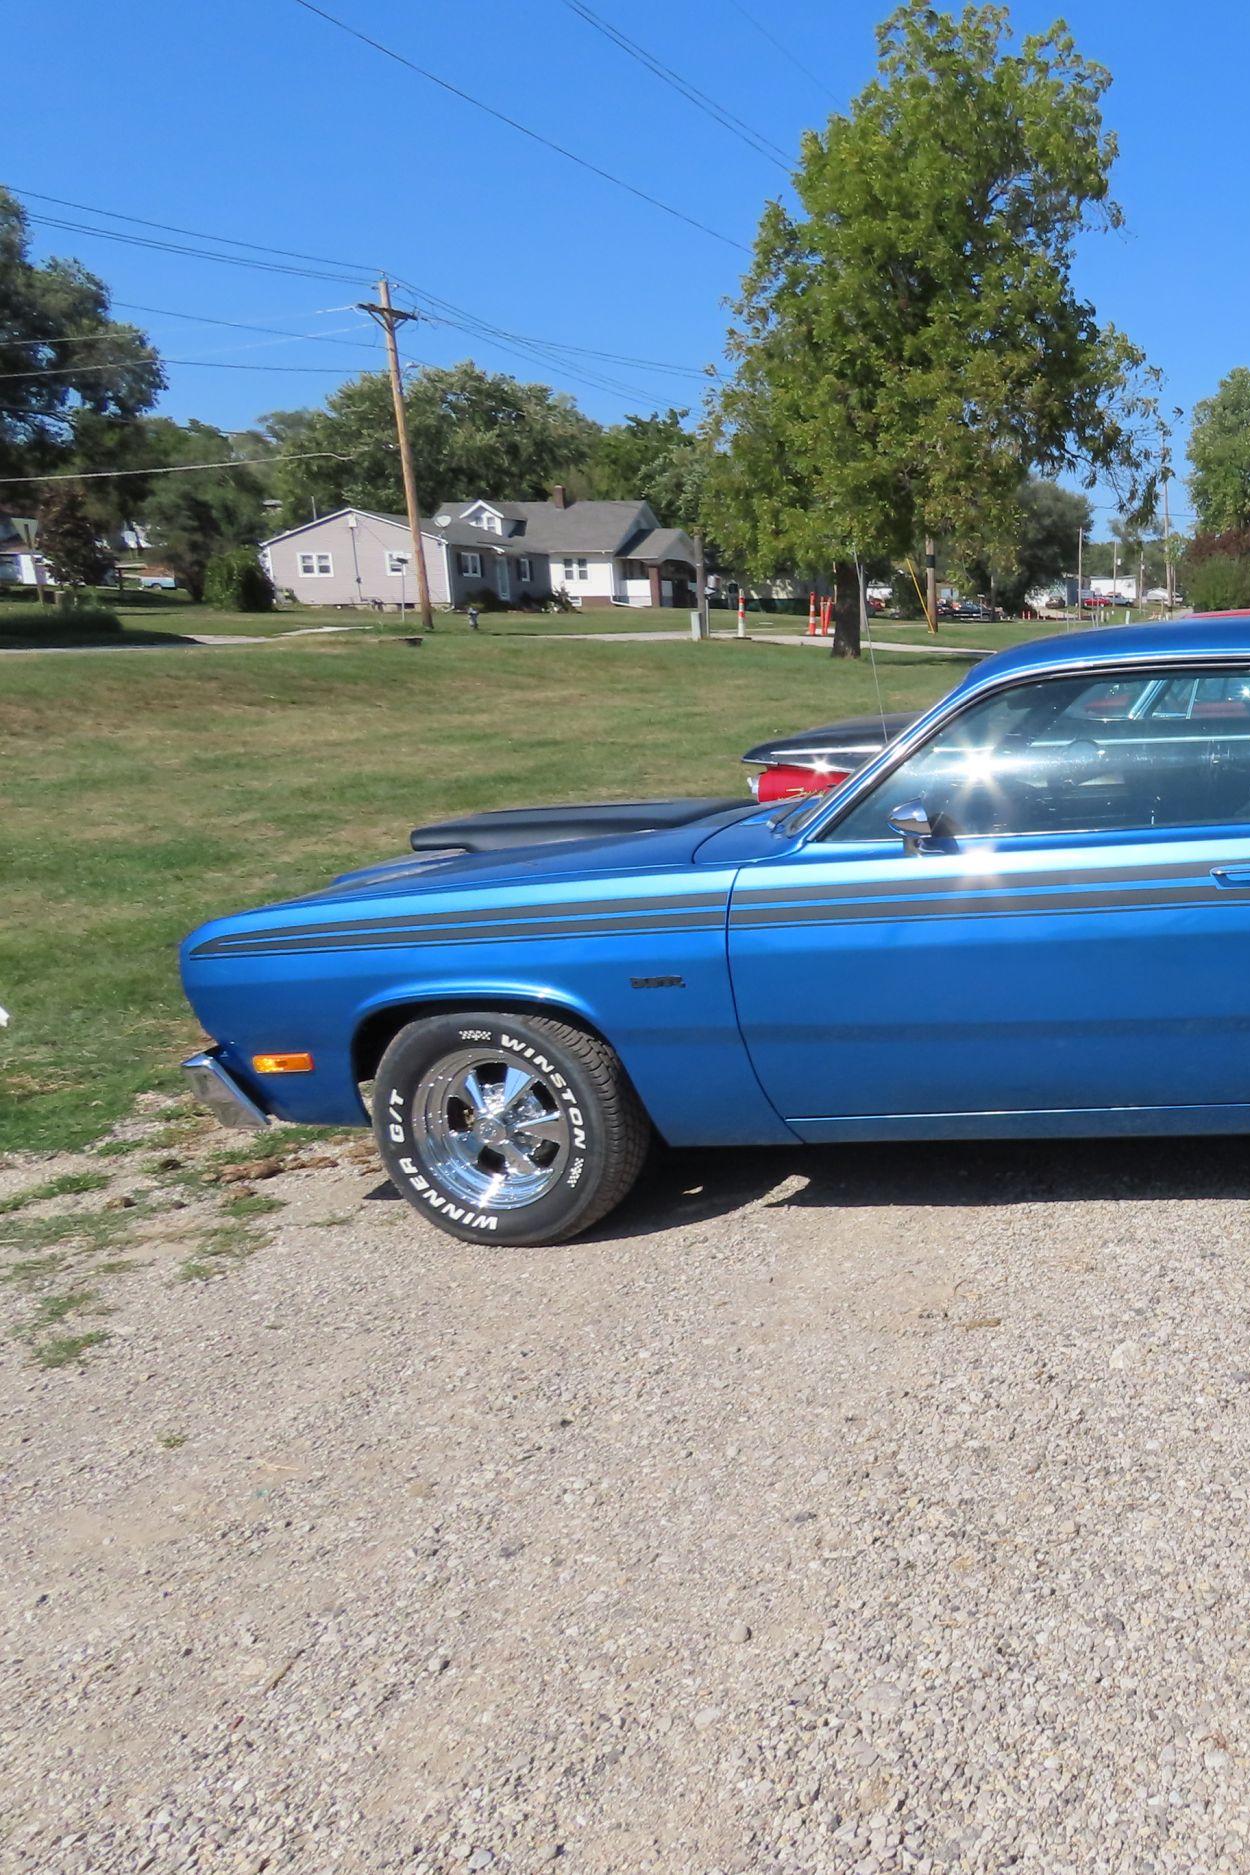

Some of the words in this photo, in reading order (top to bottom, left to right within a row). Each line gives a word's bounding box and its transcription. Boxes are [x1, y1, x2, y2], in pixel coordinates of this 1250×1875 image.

[389, 1089, 404, 1143] G/T
[501, 1034, 586, 1150] WINSTON
[399, 1157, 498, 1231] WINNER
